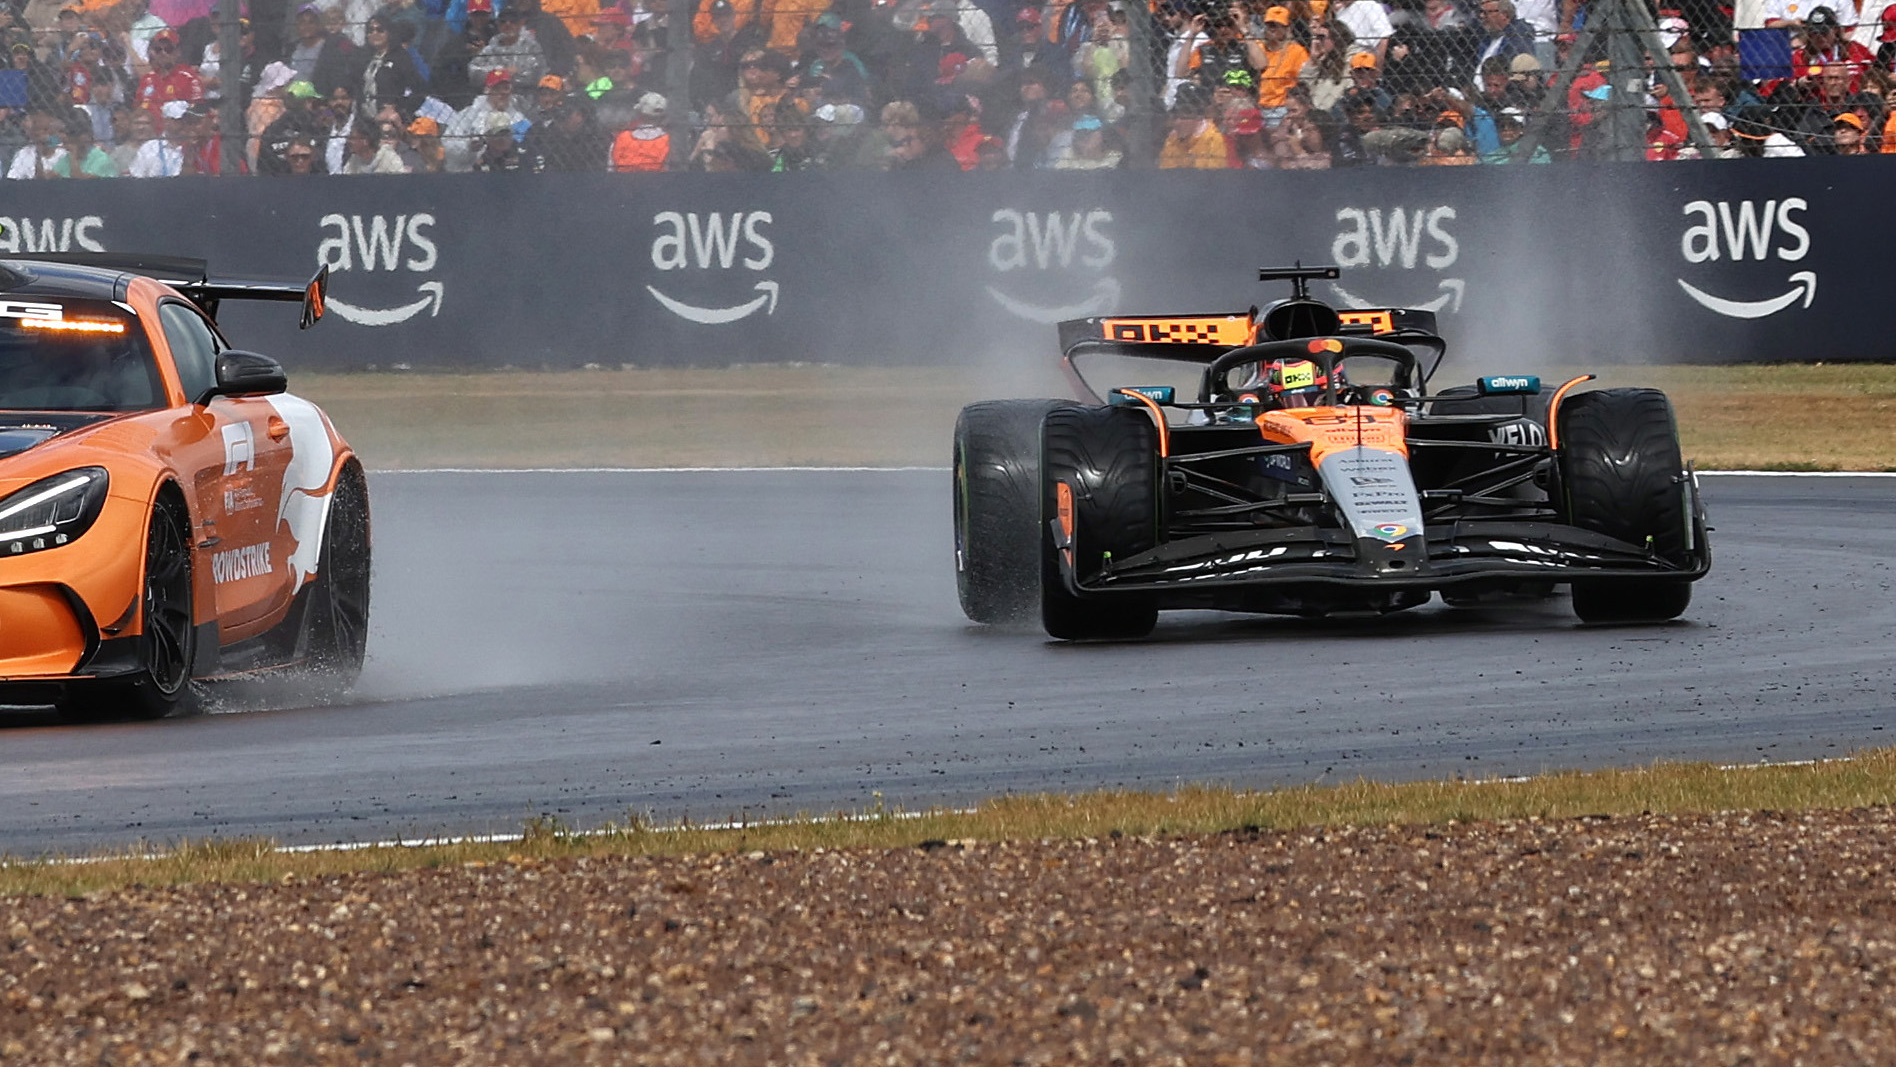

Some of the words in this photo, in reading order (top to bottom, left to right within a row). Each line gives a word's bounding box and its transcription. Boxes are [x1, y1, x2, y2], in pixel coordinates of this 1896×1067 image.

[317, 213, 436, 272] aws
[651, 210, 774, 271] aws
[988, 208, 1116, 272] aws
[1332, 205, 1459, 269] aws
[1681, 197, 1810, 263] aws
[1491, 377, 1528, 389] allwyn
